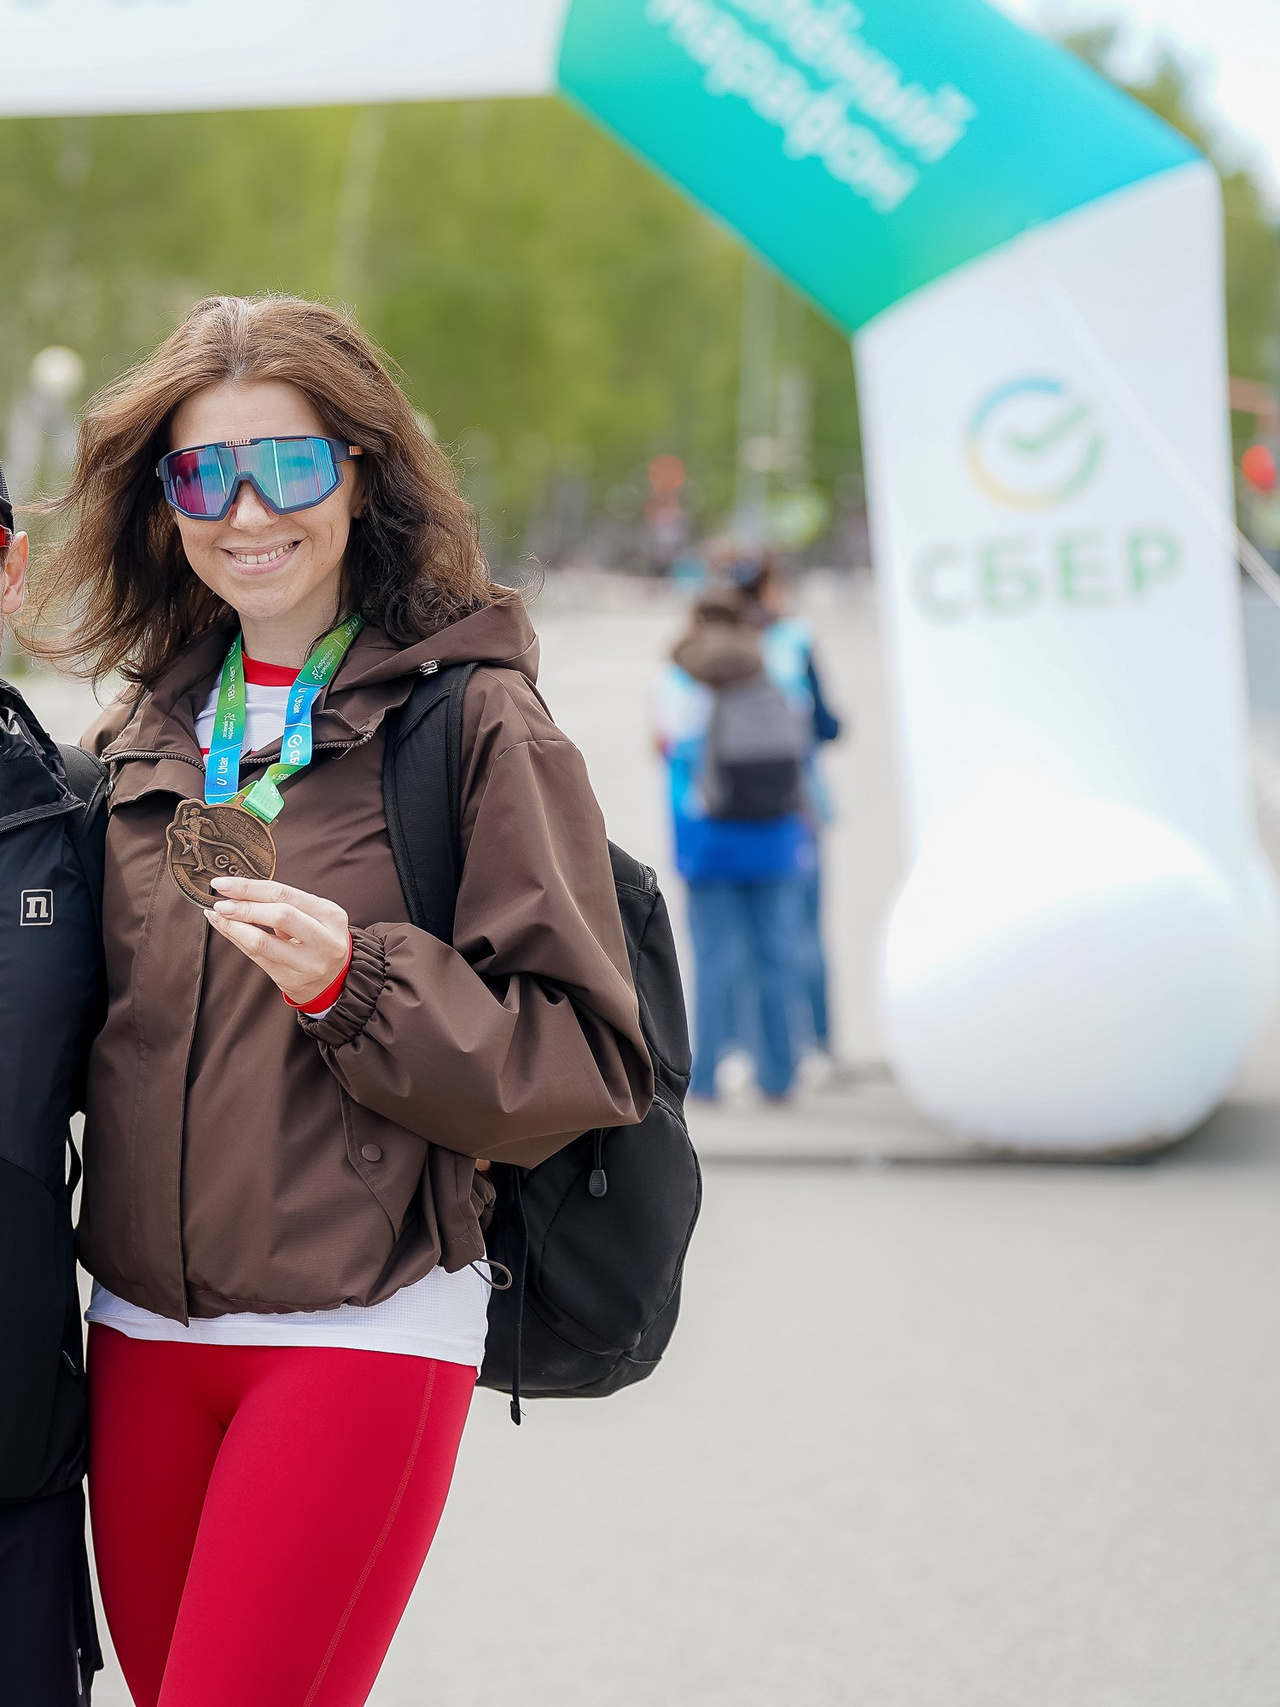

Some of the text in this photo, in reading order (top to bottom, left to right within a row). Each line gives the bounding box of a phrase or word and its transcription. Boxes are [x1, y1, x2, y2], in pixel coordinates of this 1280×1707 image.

[913, 525, 1183, 624] СБЕР
[227, 684, 235, 701] 185
[218, 757, 228, 774] Utair
[290, 749, 301, 765] СБ
